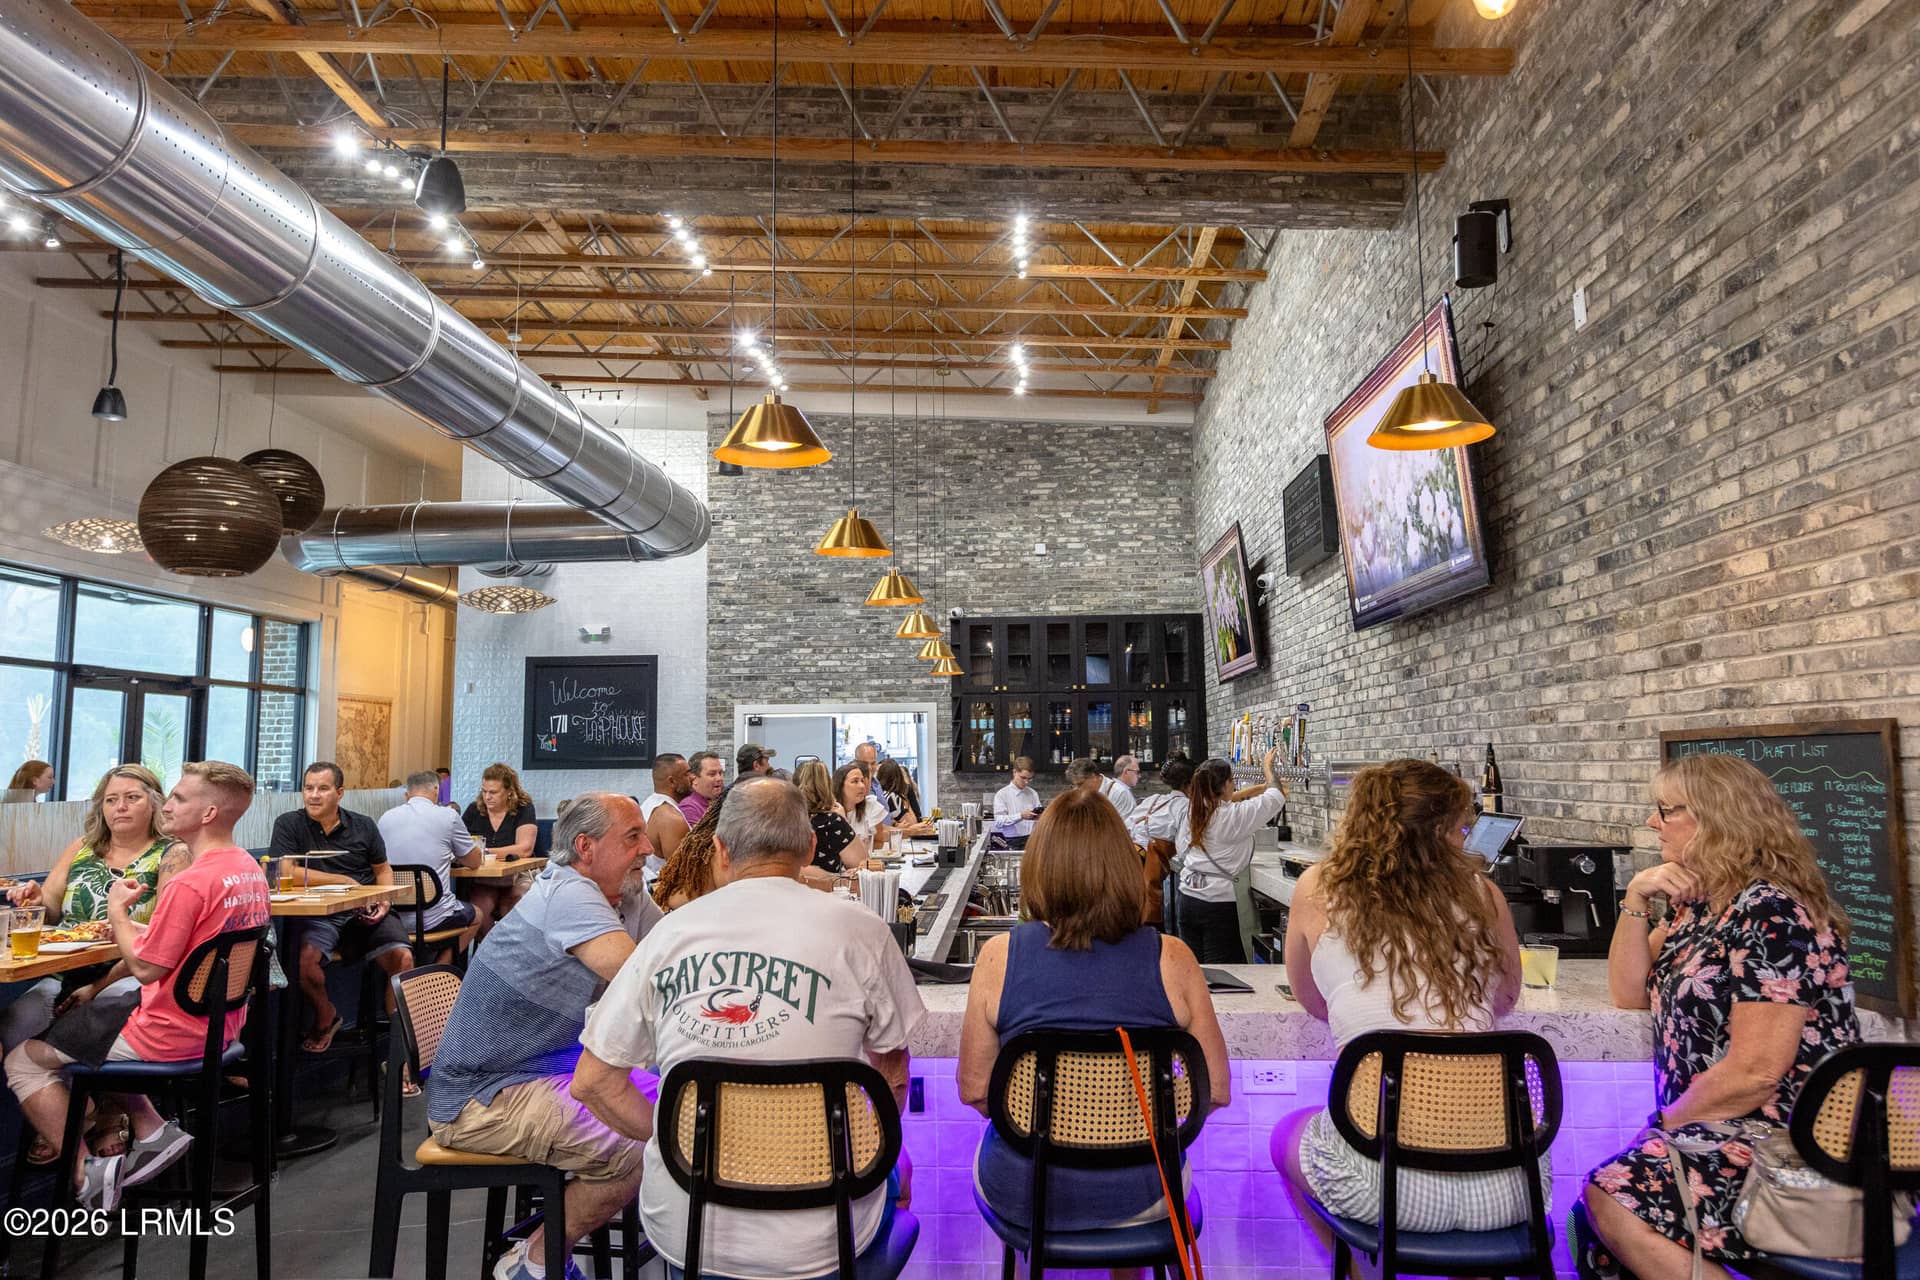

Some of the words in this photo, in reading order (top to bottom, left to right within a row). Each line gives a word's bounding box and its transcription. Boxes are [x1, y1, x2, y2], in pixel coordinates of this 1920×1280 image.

[549, 677, 622, 706] Welcome
[592, 700, 615, 712] to
[550, 714, 568, 734] 1711
[222, 874, 240, 888] NO
[655, 952, 711, 1019] BAY
[709, 951, 832, 1025] STREET
[672, 1008, 790, 1040] OUTFITTERS
[711, 1039, 739, 1049] SOUTH
[740, 1030, 780, 1047] CAROLINA
